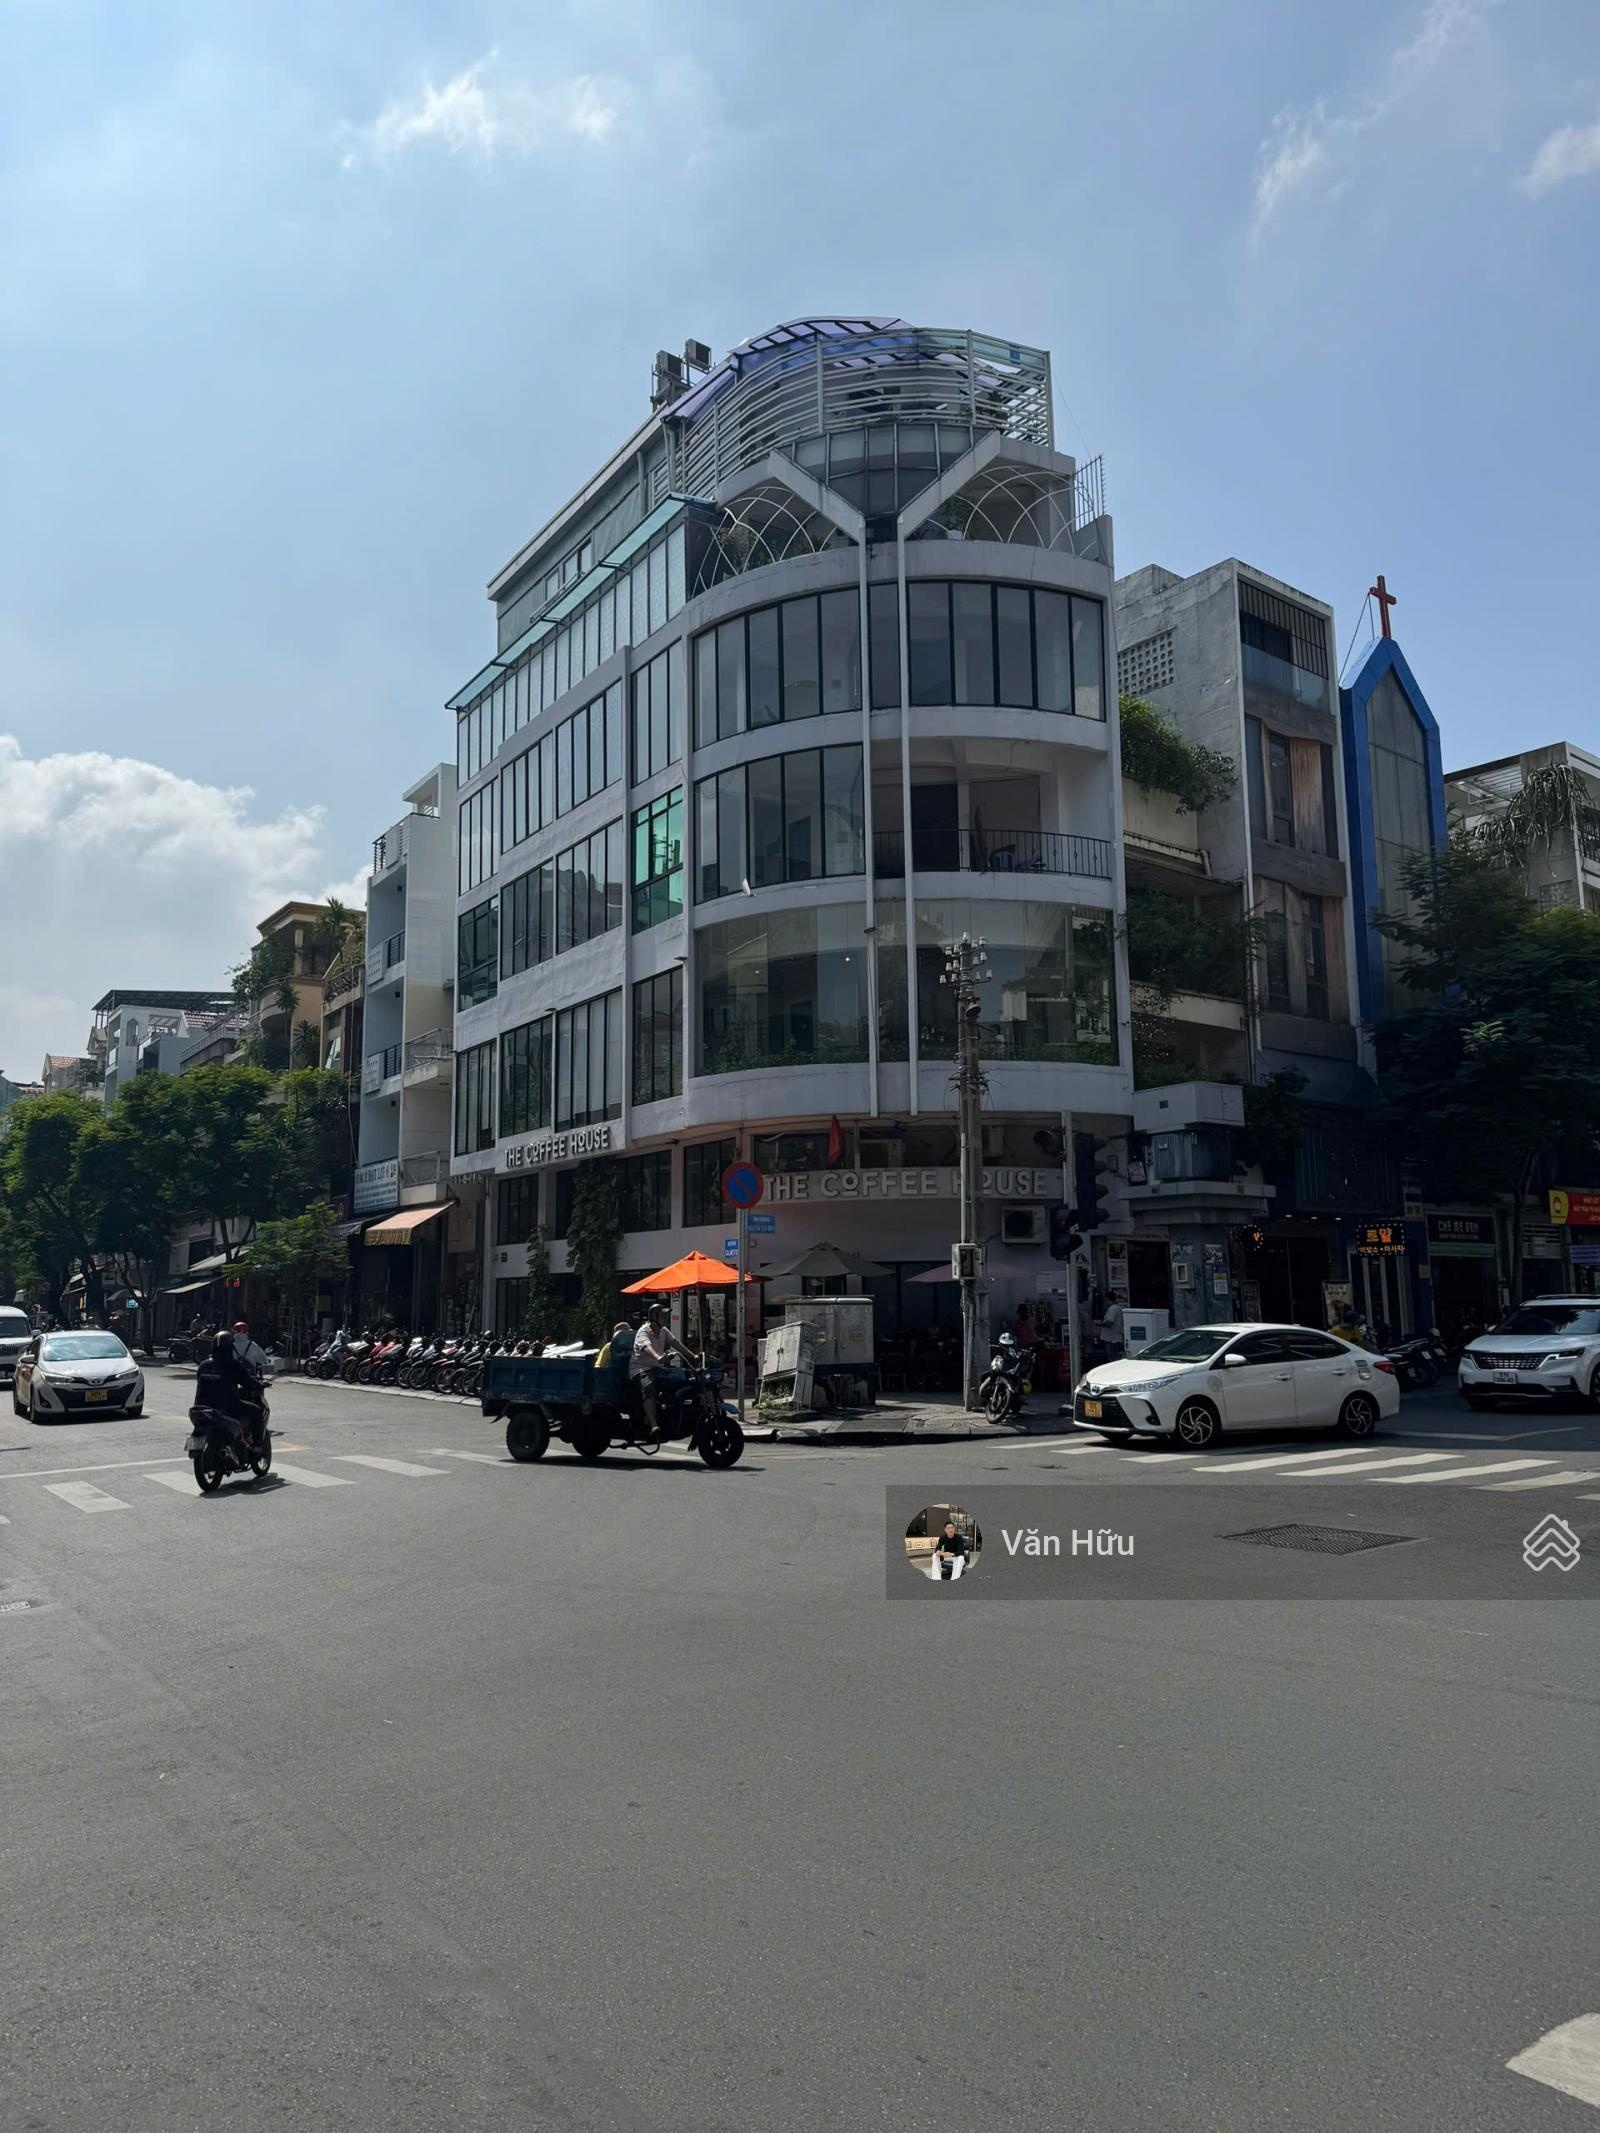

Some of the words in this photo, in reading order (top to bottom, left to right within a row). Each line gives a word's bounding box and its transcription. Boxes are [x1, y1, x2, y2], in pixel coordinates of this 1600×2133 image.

[505, 1147, 523, 1167] THE
[526, 1136, 566, 1163] COFFEE
[571, 1127, 609, 1154] HOUSE
[764, 1174, 809, 1200] THE
[821, 1171, 938, 1198] COFFEE
